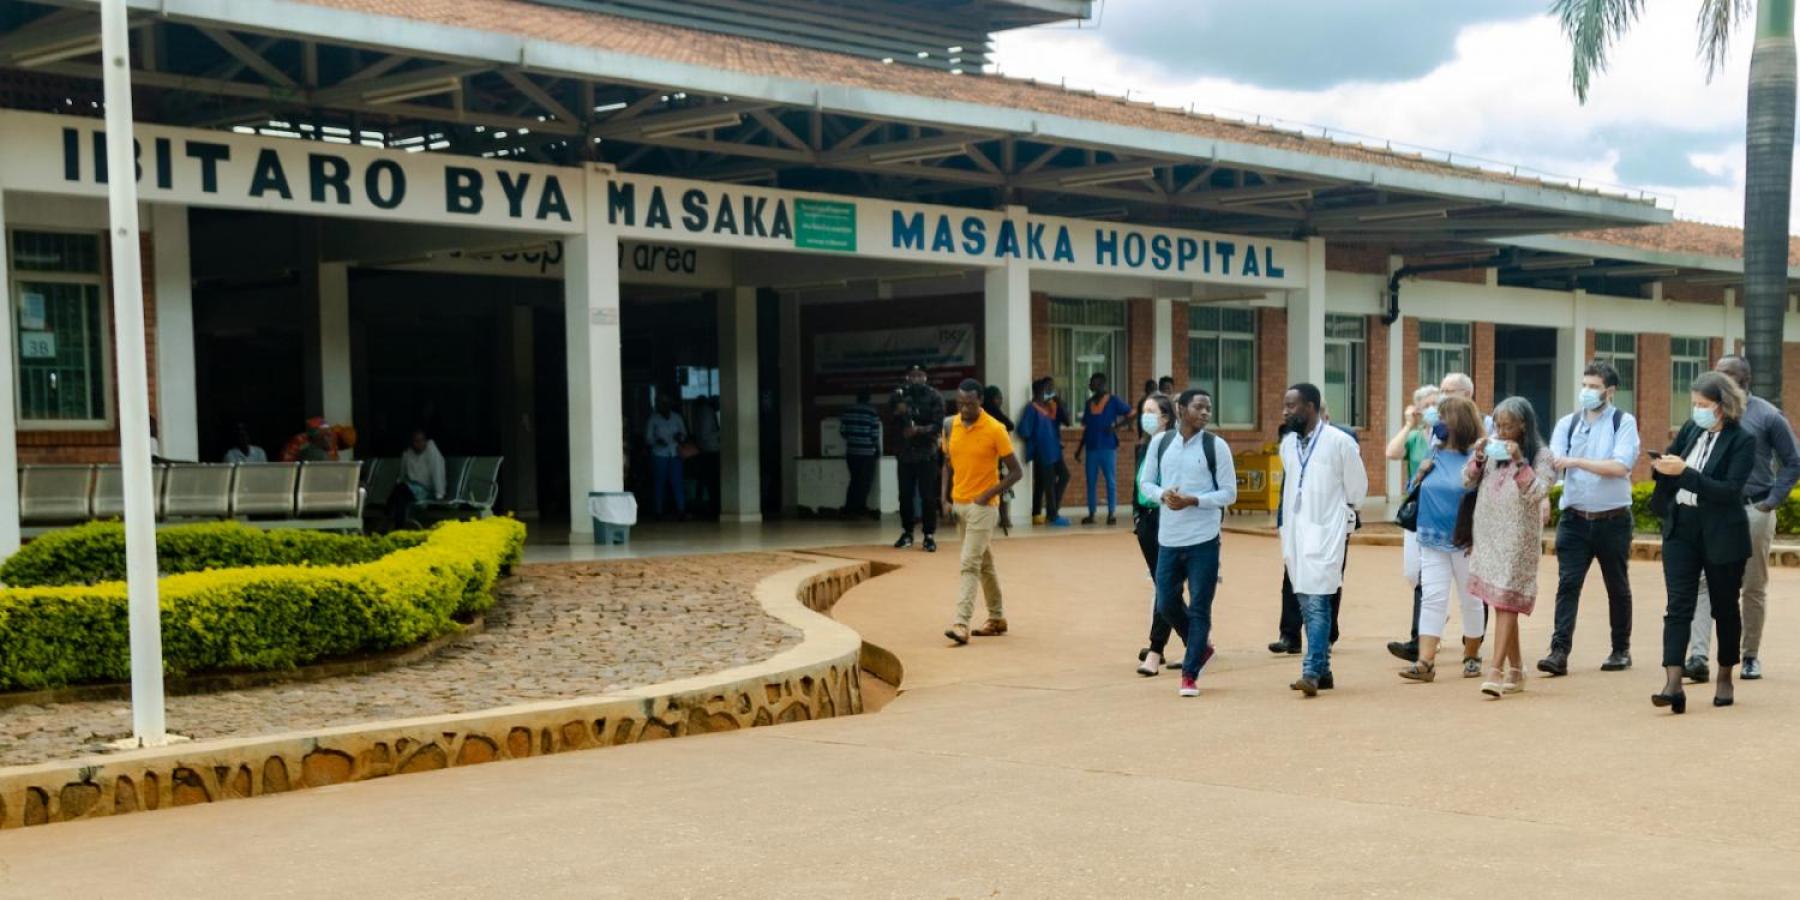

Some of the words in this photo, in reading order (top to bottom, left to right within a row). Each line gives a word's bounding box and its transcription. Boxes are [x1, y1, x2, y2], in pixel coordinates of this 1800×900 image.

[444, 165, 572, 222] BYA
[607, 179, 793, 240] MASAKA
[633, 244, 696, 273] area
[891, 209, 1075, 263] MASAKA
[1096, 229, 1284, 278] HOSPITAL
